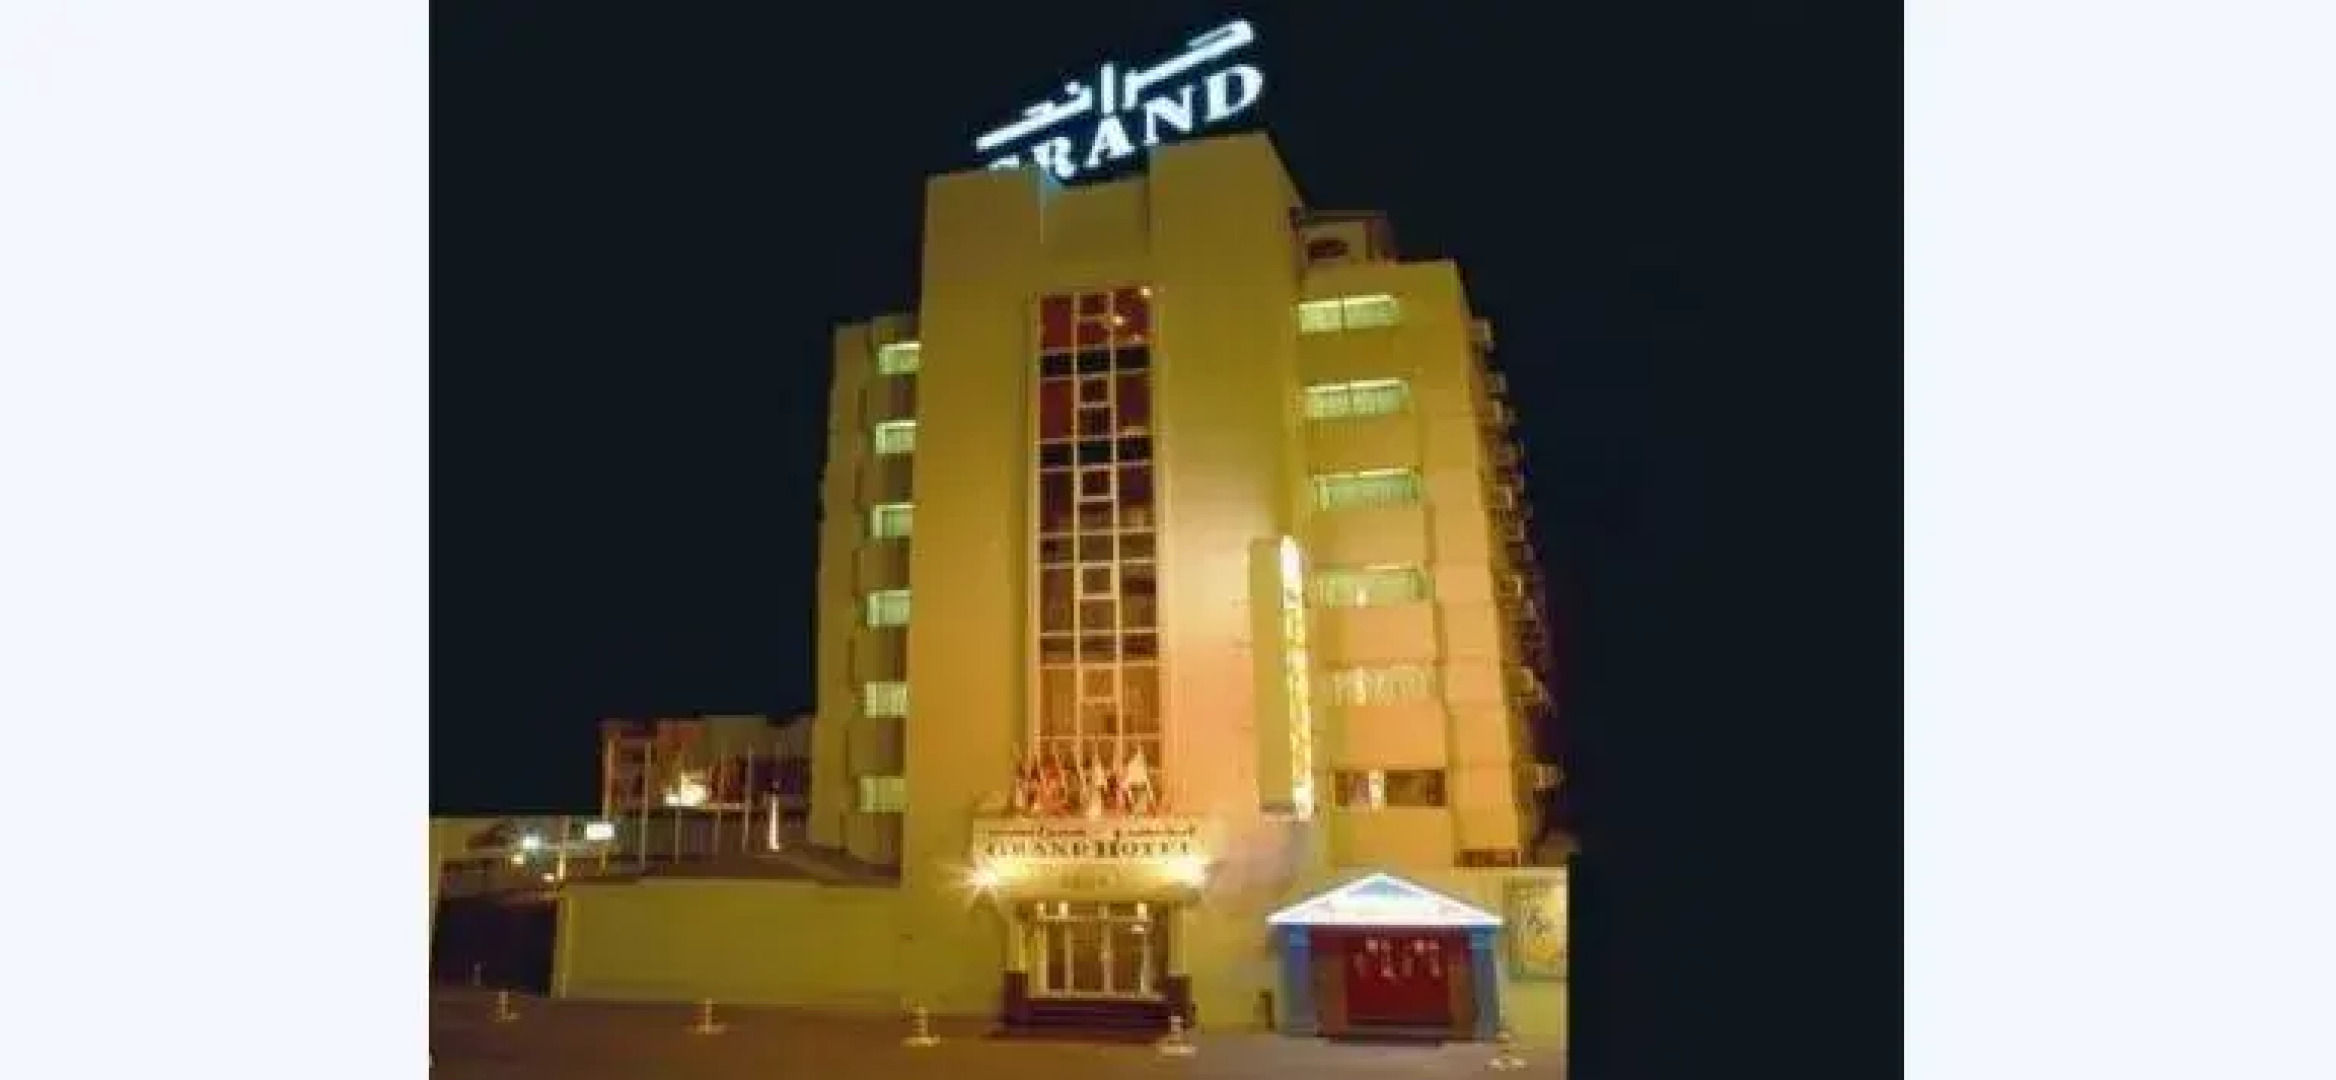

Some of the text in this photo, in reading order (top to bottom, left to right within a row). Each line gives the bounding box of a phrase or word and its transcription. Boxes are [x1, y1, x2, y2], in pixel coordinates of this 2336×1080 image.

[988, 64, 1266, 178] RAND
[985, 841, 1196, 859] GRAND HOTEL
